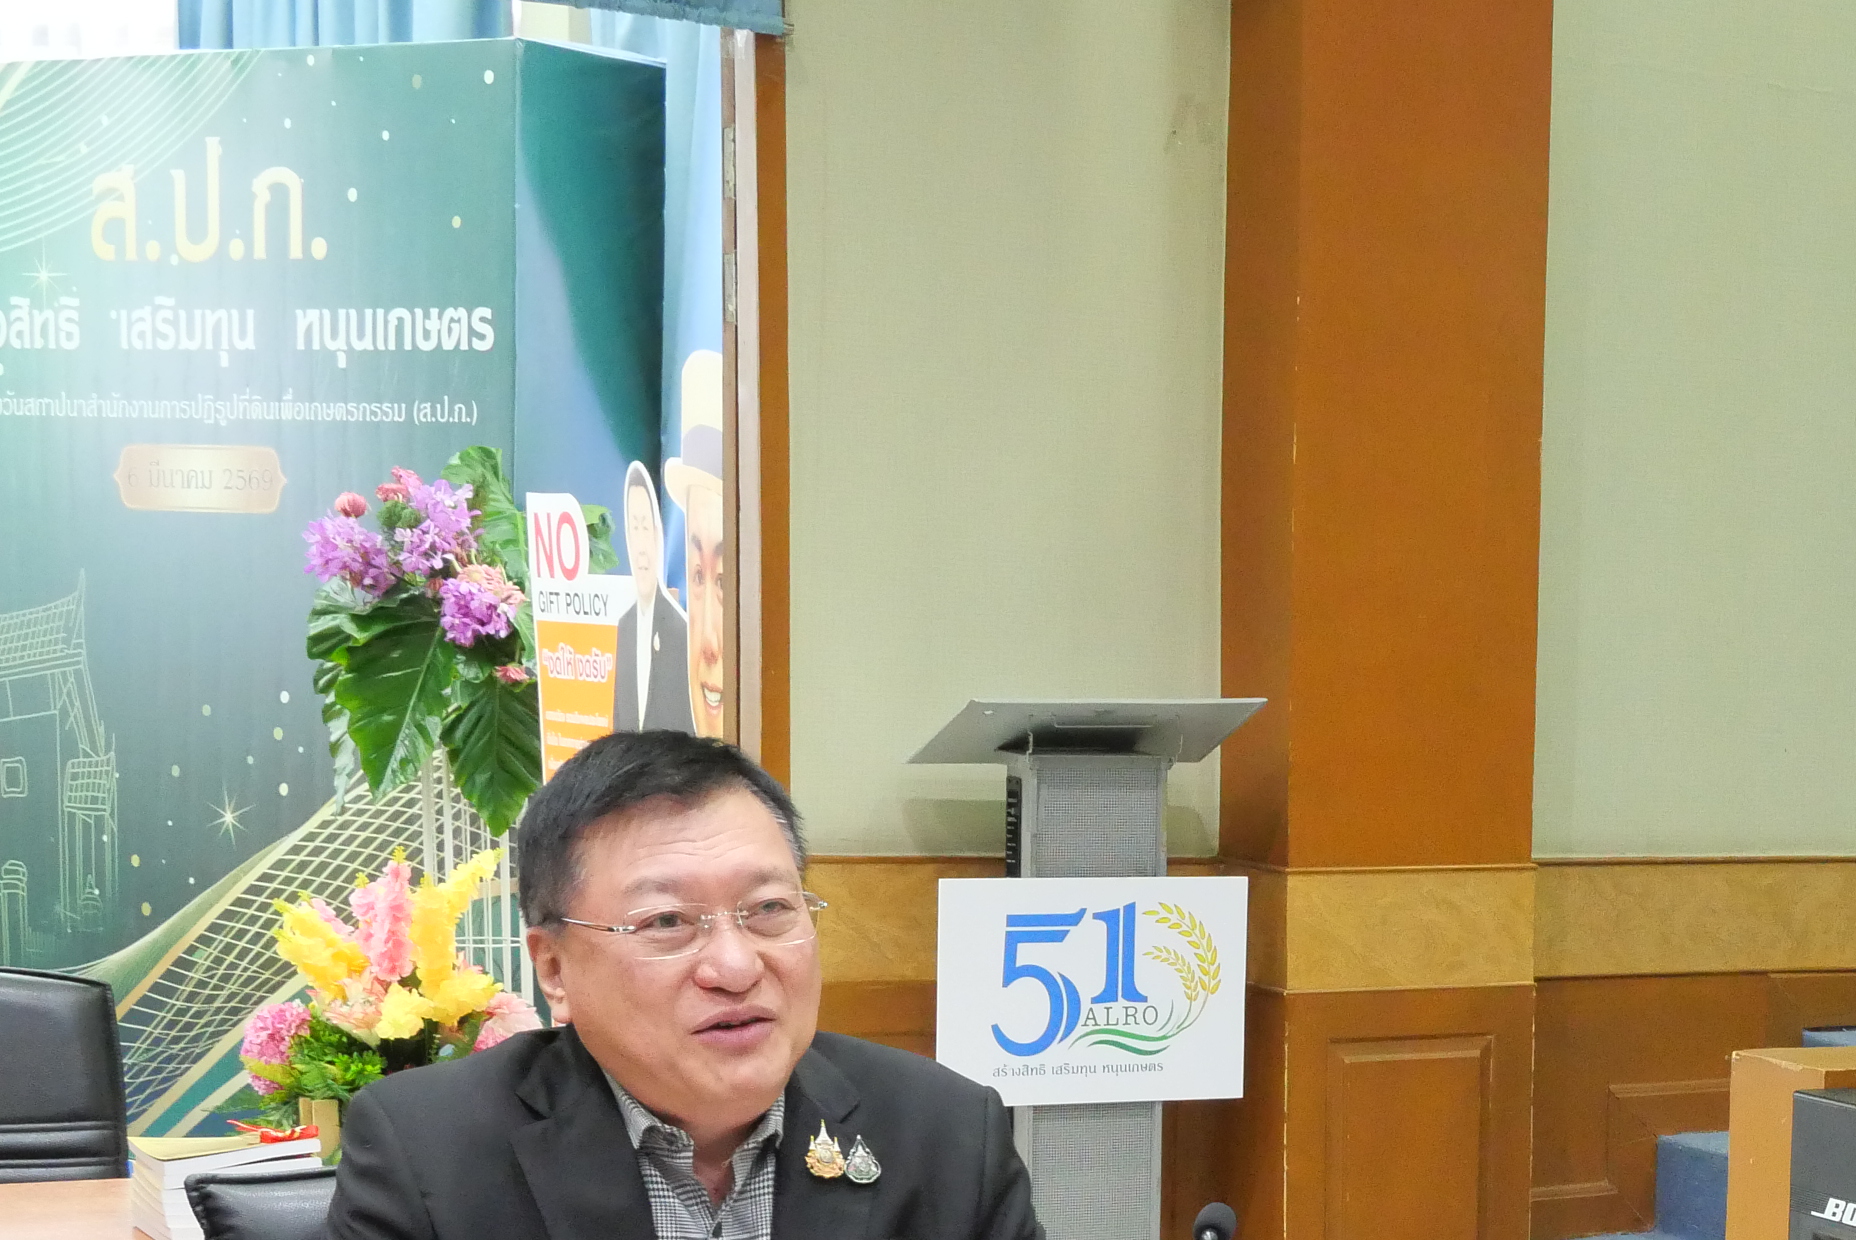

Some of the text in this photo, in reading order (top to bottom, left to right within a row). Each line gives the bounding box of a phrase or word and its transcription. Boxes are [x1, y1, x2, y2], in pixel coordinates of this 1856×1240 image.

[91, 136, 328, 263] ส.ป.ก.
[0, 296, 495, 368] สิทธิ เสริมทุน หนุนเกษตร
[0, 387, 478, 426] วันสถาปนาสำนักงานการปฏิรูปที่ดินเพื่อเกษตรกรรม (ส.ป.ก.)
[148, 460, 213, 490] มีนาคม
[222, 468, 274, 491] 2569
[533, 511, 581, 581] NO
[538, 590, 609, 617] GIFT POLICY
[990, 901, 1149, 1057] 51
[1081, 1004, 1160, 1029] ALRO
[1051, 1062, 1097, 1078] เสริมทุน
[1101, 1061, 1164, 1077] หนุนเกษตร
